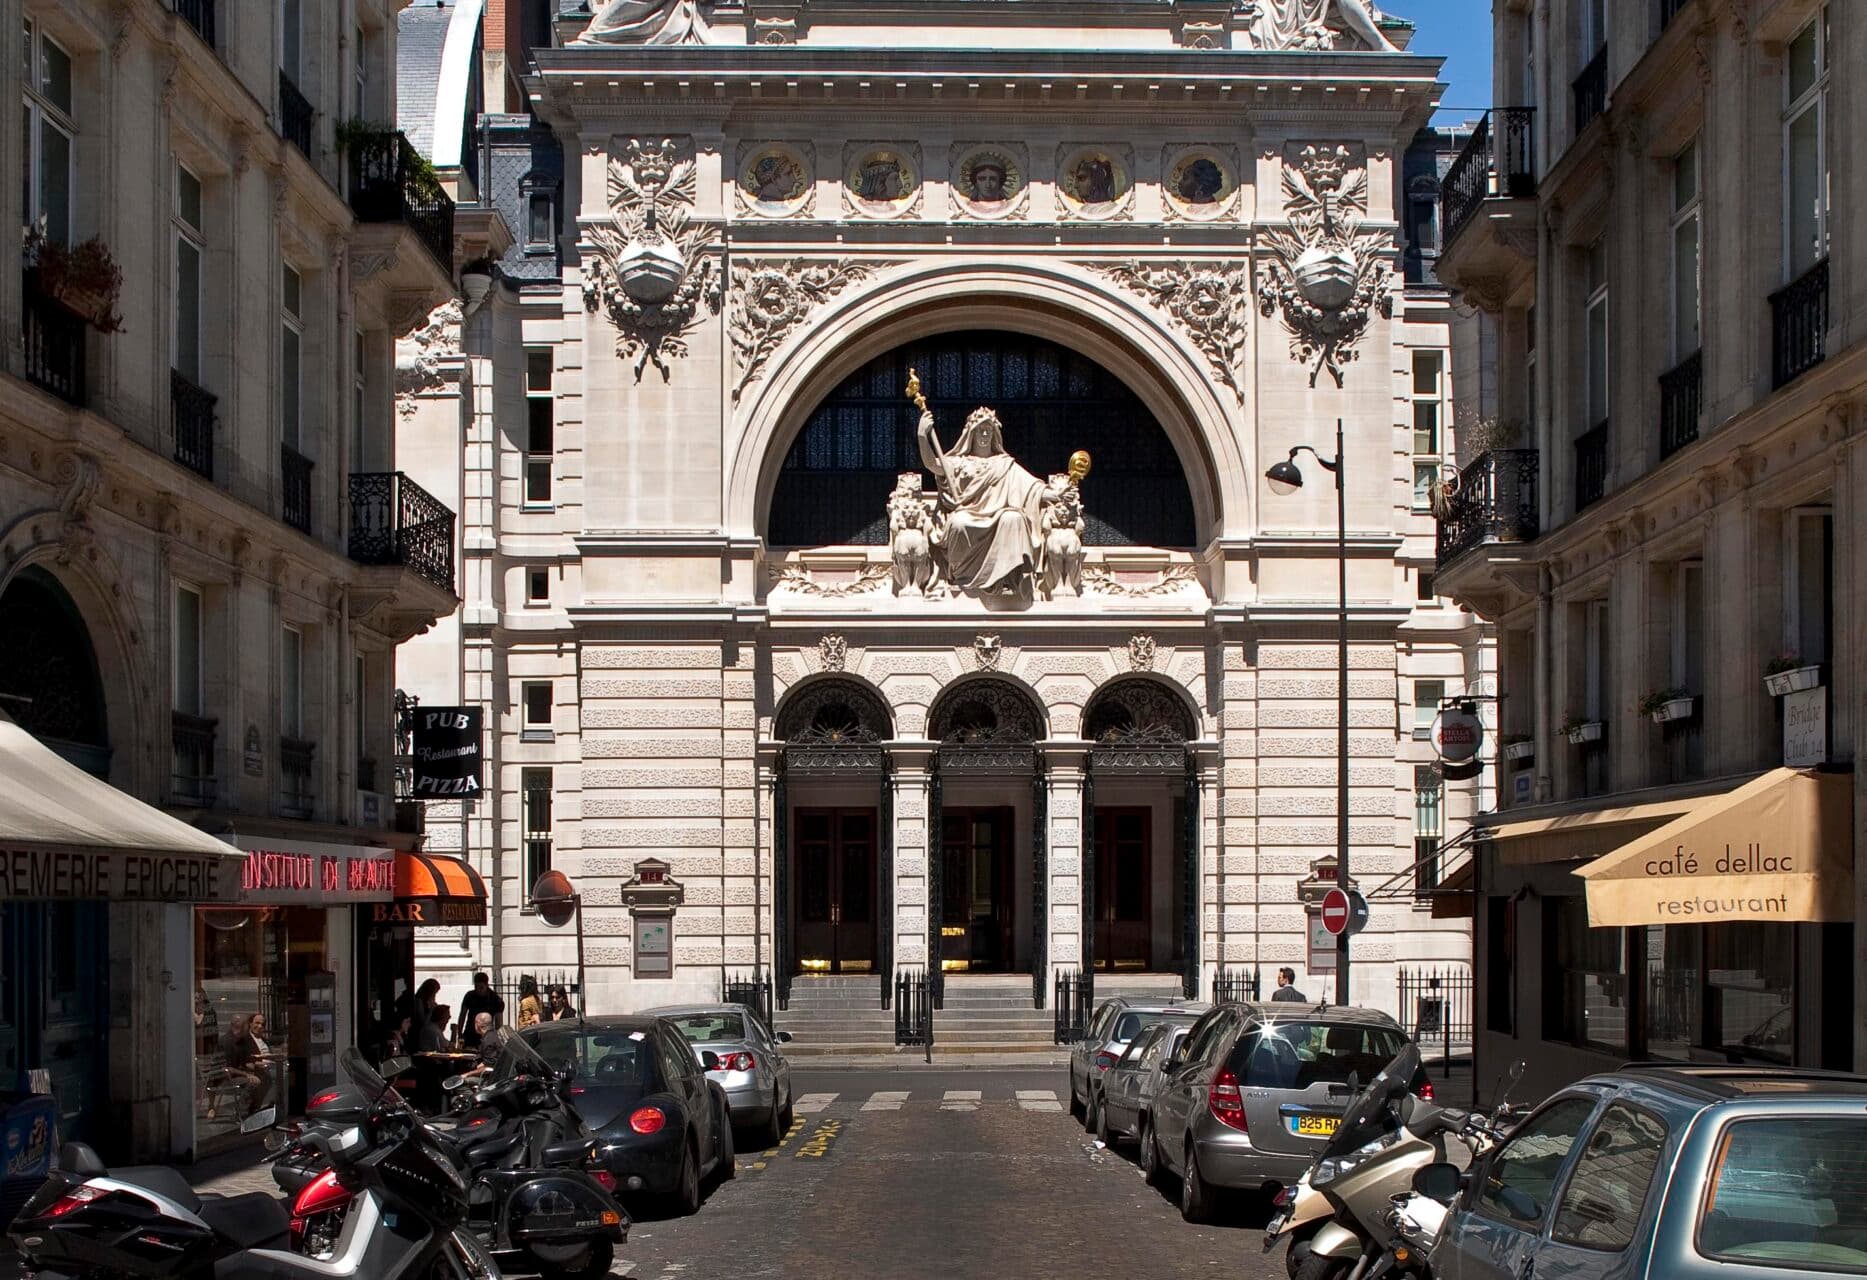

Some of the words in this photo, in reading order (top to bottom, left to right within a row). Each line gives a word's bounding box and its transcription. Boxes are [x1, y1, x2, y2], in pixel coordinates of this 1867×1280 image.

[425, 712, 470, 729] PUB
[1789, 696, 1821, 733] Bridge
[417, 742, 478, 762] Restaurant
[1784, 732, 1807, 760] Club
[417, 775, 480, 794] PIZZA
[240, 850, 315, 890] INSTITUT
[322, 857, 341, 890] DE
[1645, 845, 1698, 876] café
[1715, 843, 1793, 873] dellac
[124, 856, 219, 898] EPICERIE
[373, 903, 424, 921] BAR
[1657, 893, 1788, 915] restaurant
[1299, 1116, 1322, 1130] 825
